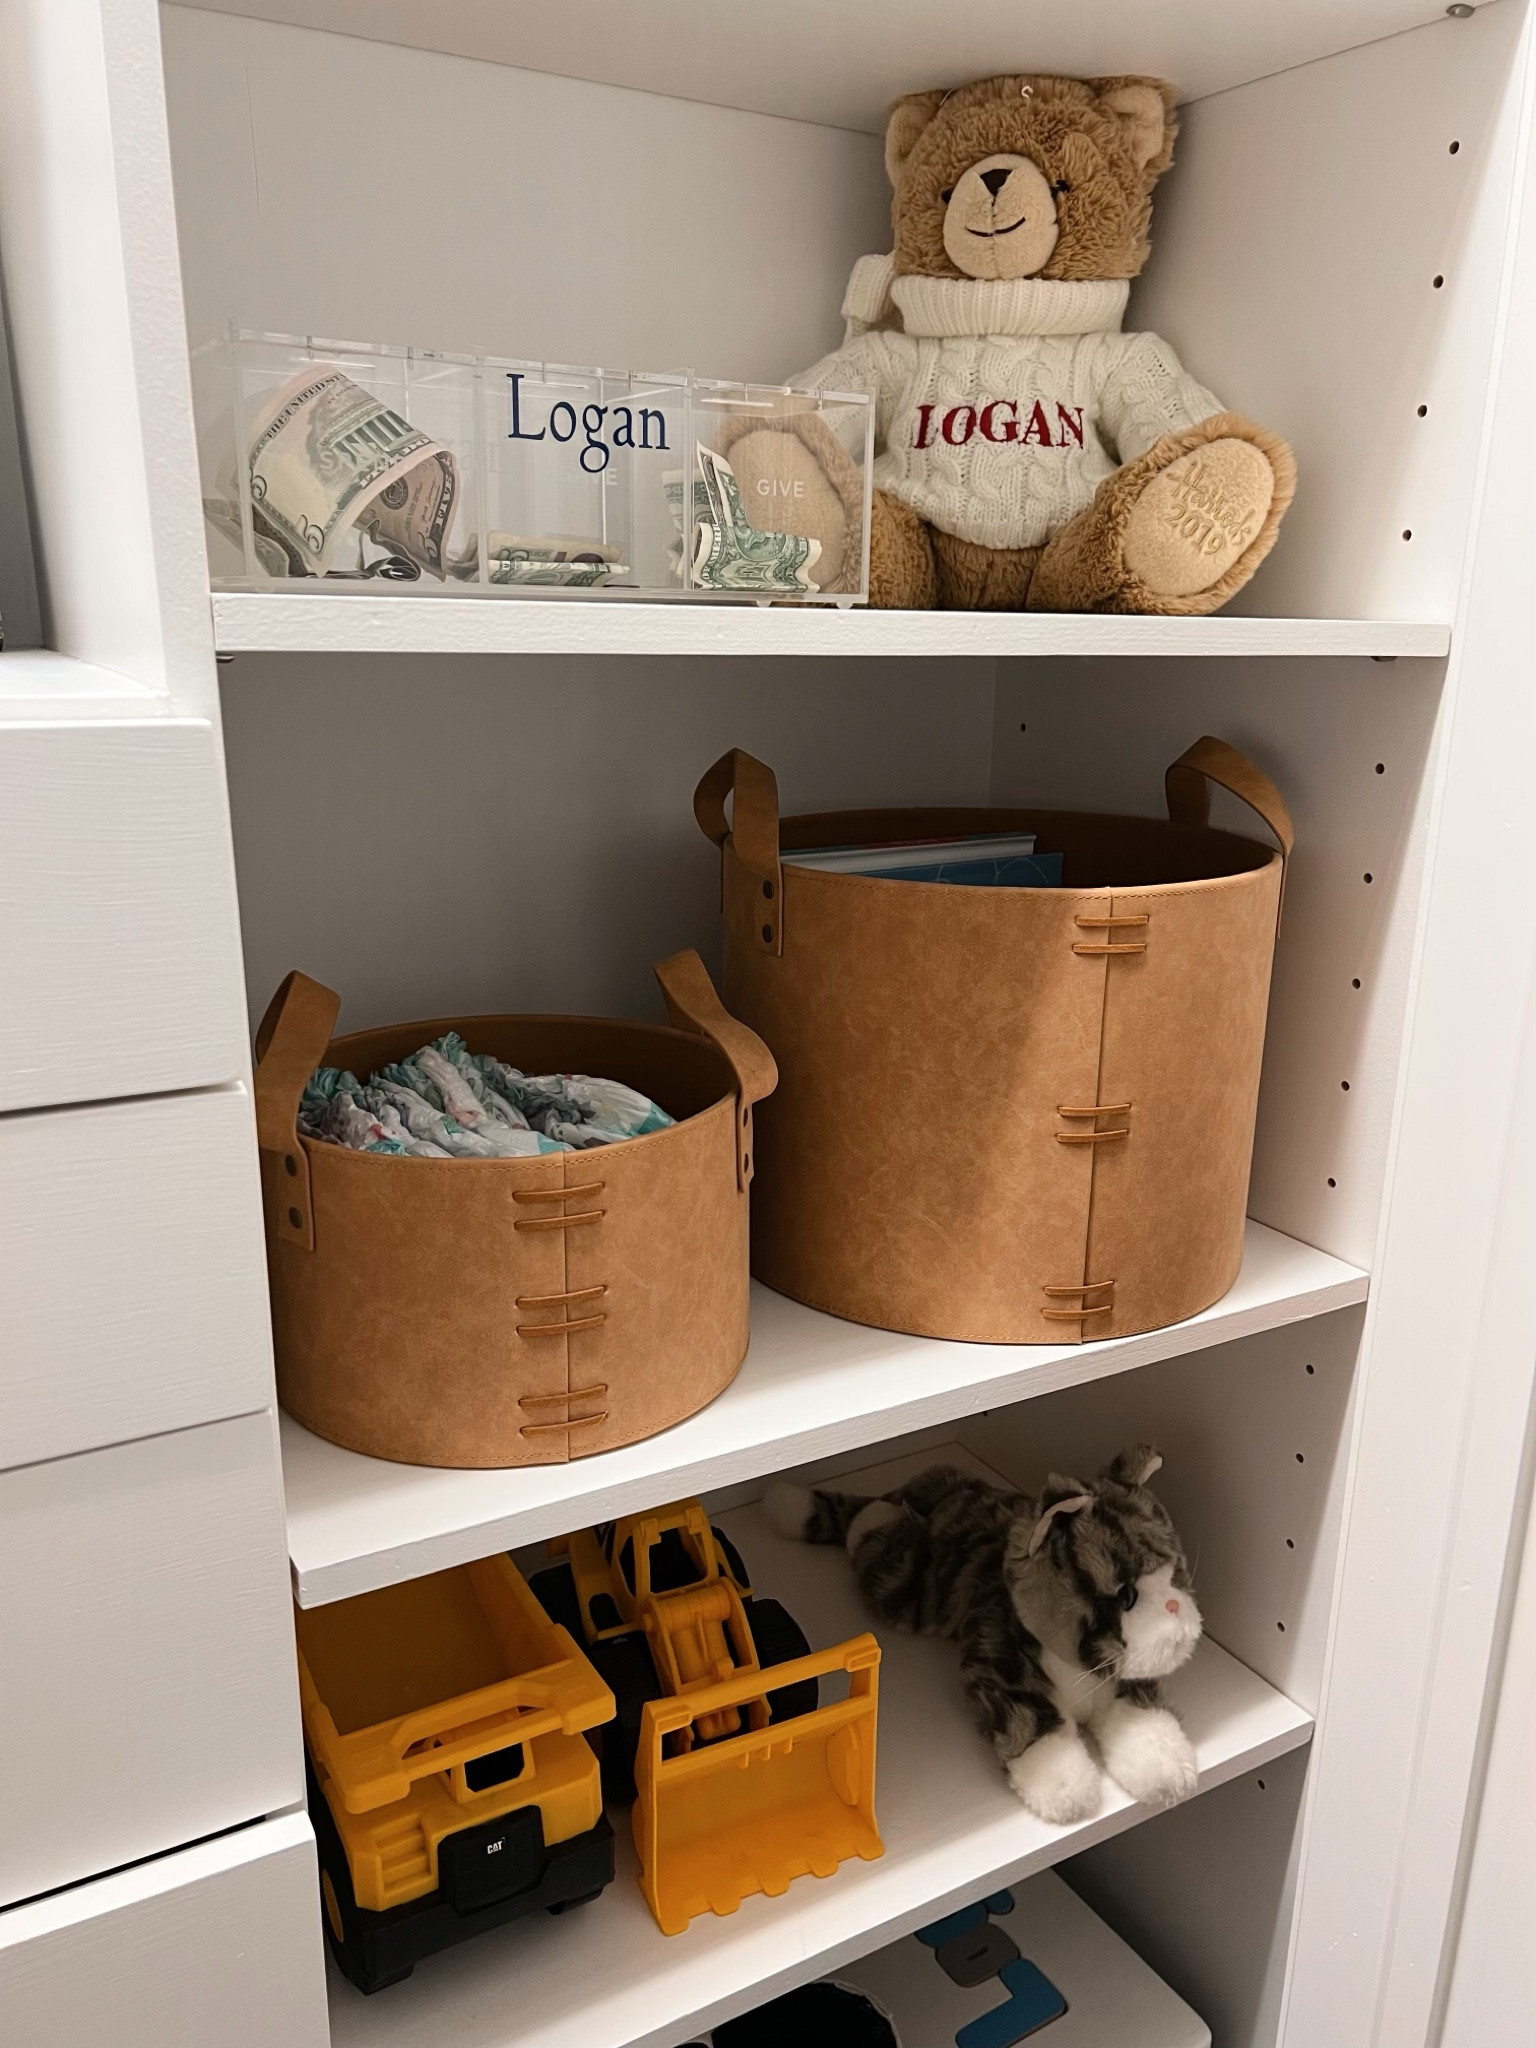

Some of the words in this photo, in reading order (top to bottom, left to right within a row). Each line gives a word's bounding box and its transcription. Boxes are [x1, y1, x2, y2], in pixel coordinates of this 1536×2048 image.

[285, 381, 326, 417] UNITED
[506, 373, 670, 473] Logan
[756, 478, 805, 499] GIVE
[1163, 503, 1226, 556] 2019
[487, 1840, 503, 1854] CAT
